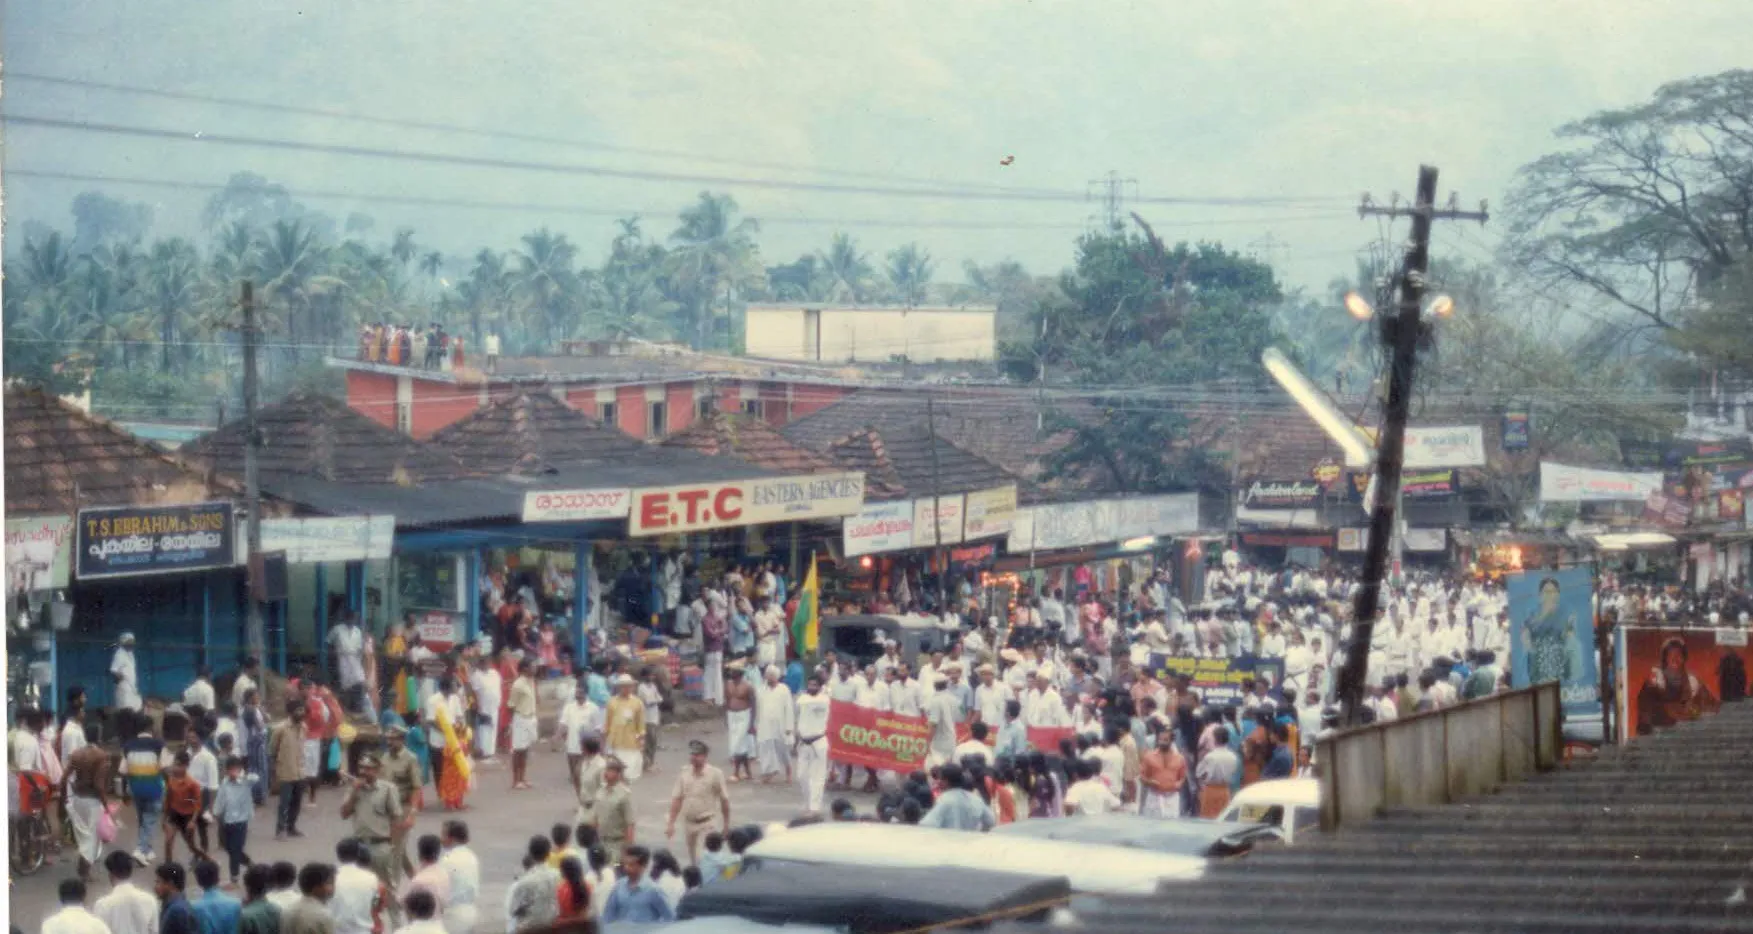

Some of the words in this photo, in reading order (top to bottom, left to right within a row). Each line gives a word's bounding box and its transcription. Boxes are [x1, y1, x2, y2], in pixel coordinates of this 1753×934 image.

[752, 482, 805, 506] EASTERN
[808, 477, 864, 501] AGENCIES
[190, 511, 225, 531] SONS
[640, 486, 744, 530] E.T.C
